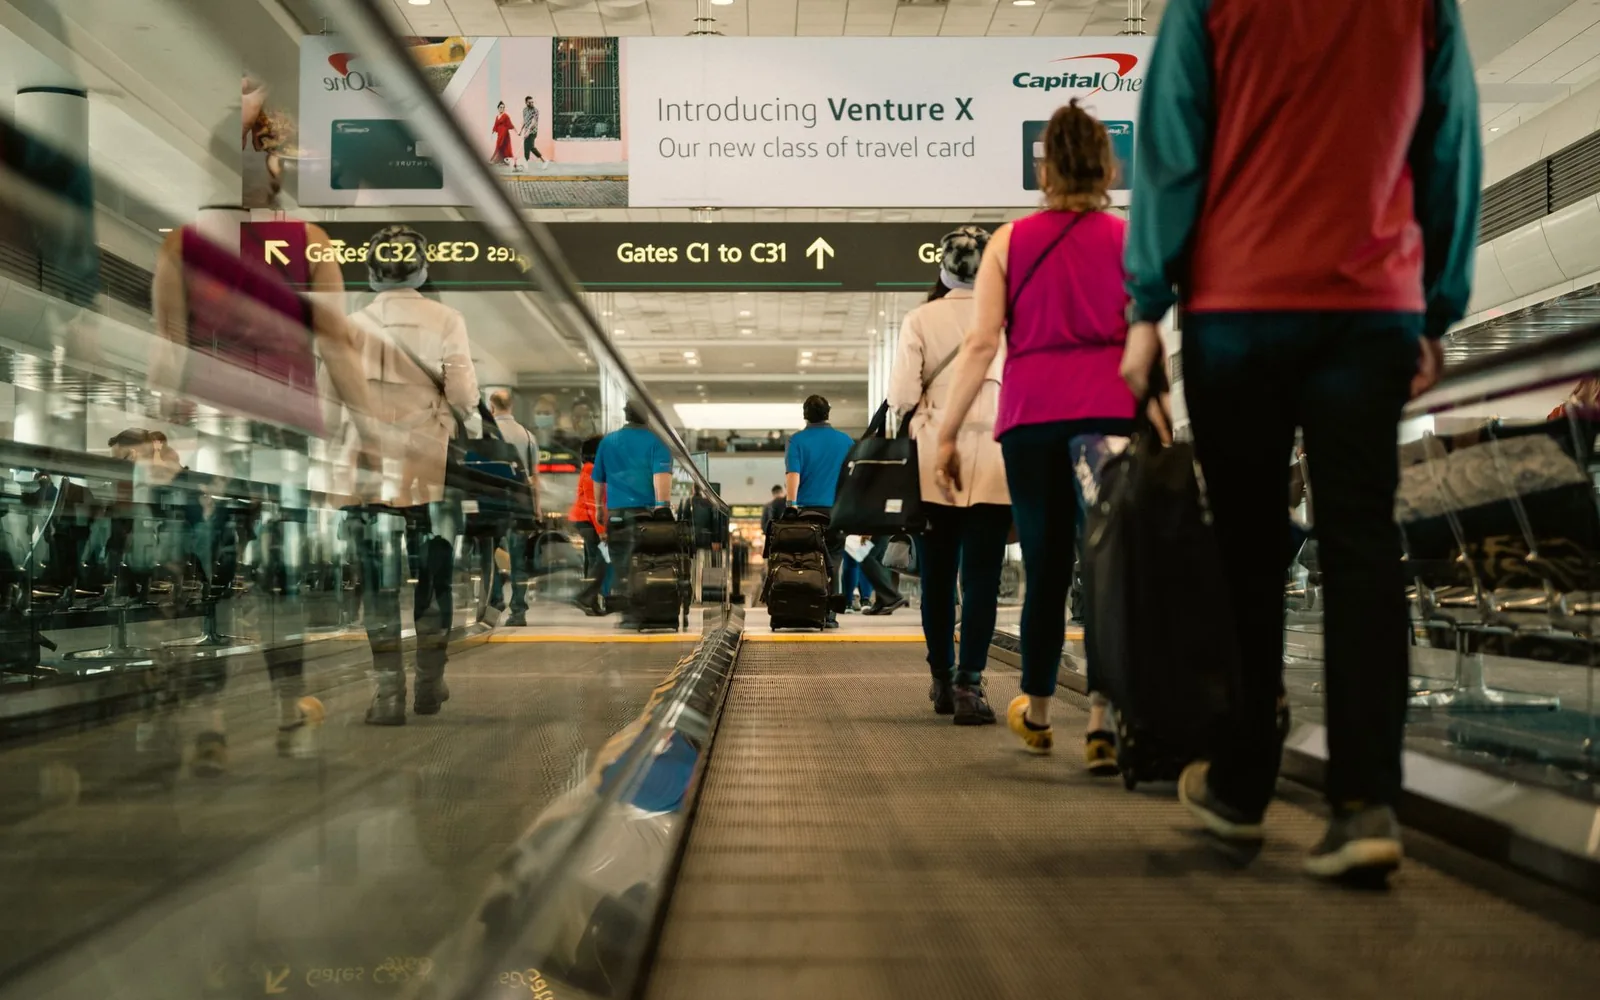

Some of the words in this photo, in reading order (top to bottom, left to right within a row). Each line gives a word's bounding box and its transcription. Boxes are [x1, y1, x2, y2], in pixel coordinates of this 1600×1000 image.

[658, 96, 817, 128] Introducing
[827, 97, 945, 121] Venture
[954, 97, 974, 121] X
[658, 137, 700, 158] Our
[709, 142, 755, 158] new
[763, 136, 819, 158] class
[826, 136, 849, 158] of
[856, 136, 918, 158] travel
[926, 136, 975, 158] card
[305, 242, 367, 263] Gates
[375, 242, 417, 263] C32
[616, 242, 678, 263] Gates
[686, 242, 710, 263] C1
[718, 244, 742, 263] to
[750, 242, 787, 263] C31
